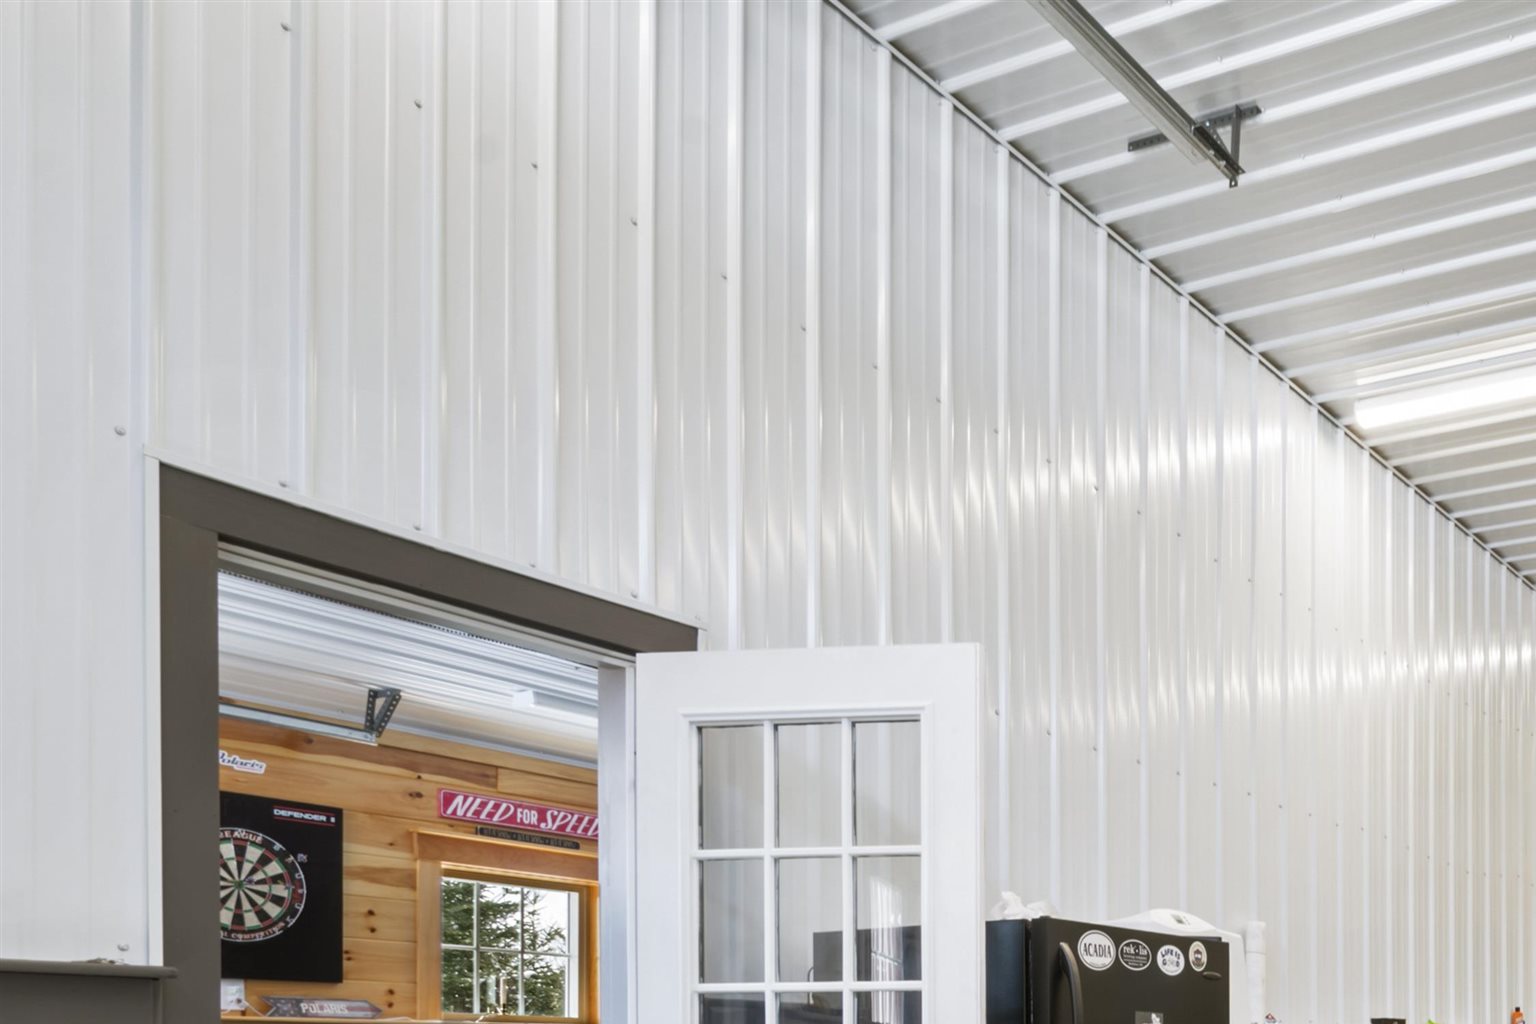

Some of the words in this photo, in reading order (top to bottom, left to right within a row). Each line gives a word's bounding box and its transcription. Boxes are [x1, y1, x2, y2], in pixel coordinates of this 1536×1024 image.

[273, 809, 326, 822] DEFENDER
[446, 795, 514, 822] NEED
[516, 808, 538, 826] FOR
[1083, 942, 1112, 958] ACADIA
[300, 1003, 348, 1014] POLARIS
